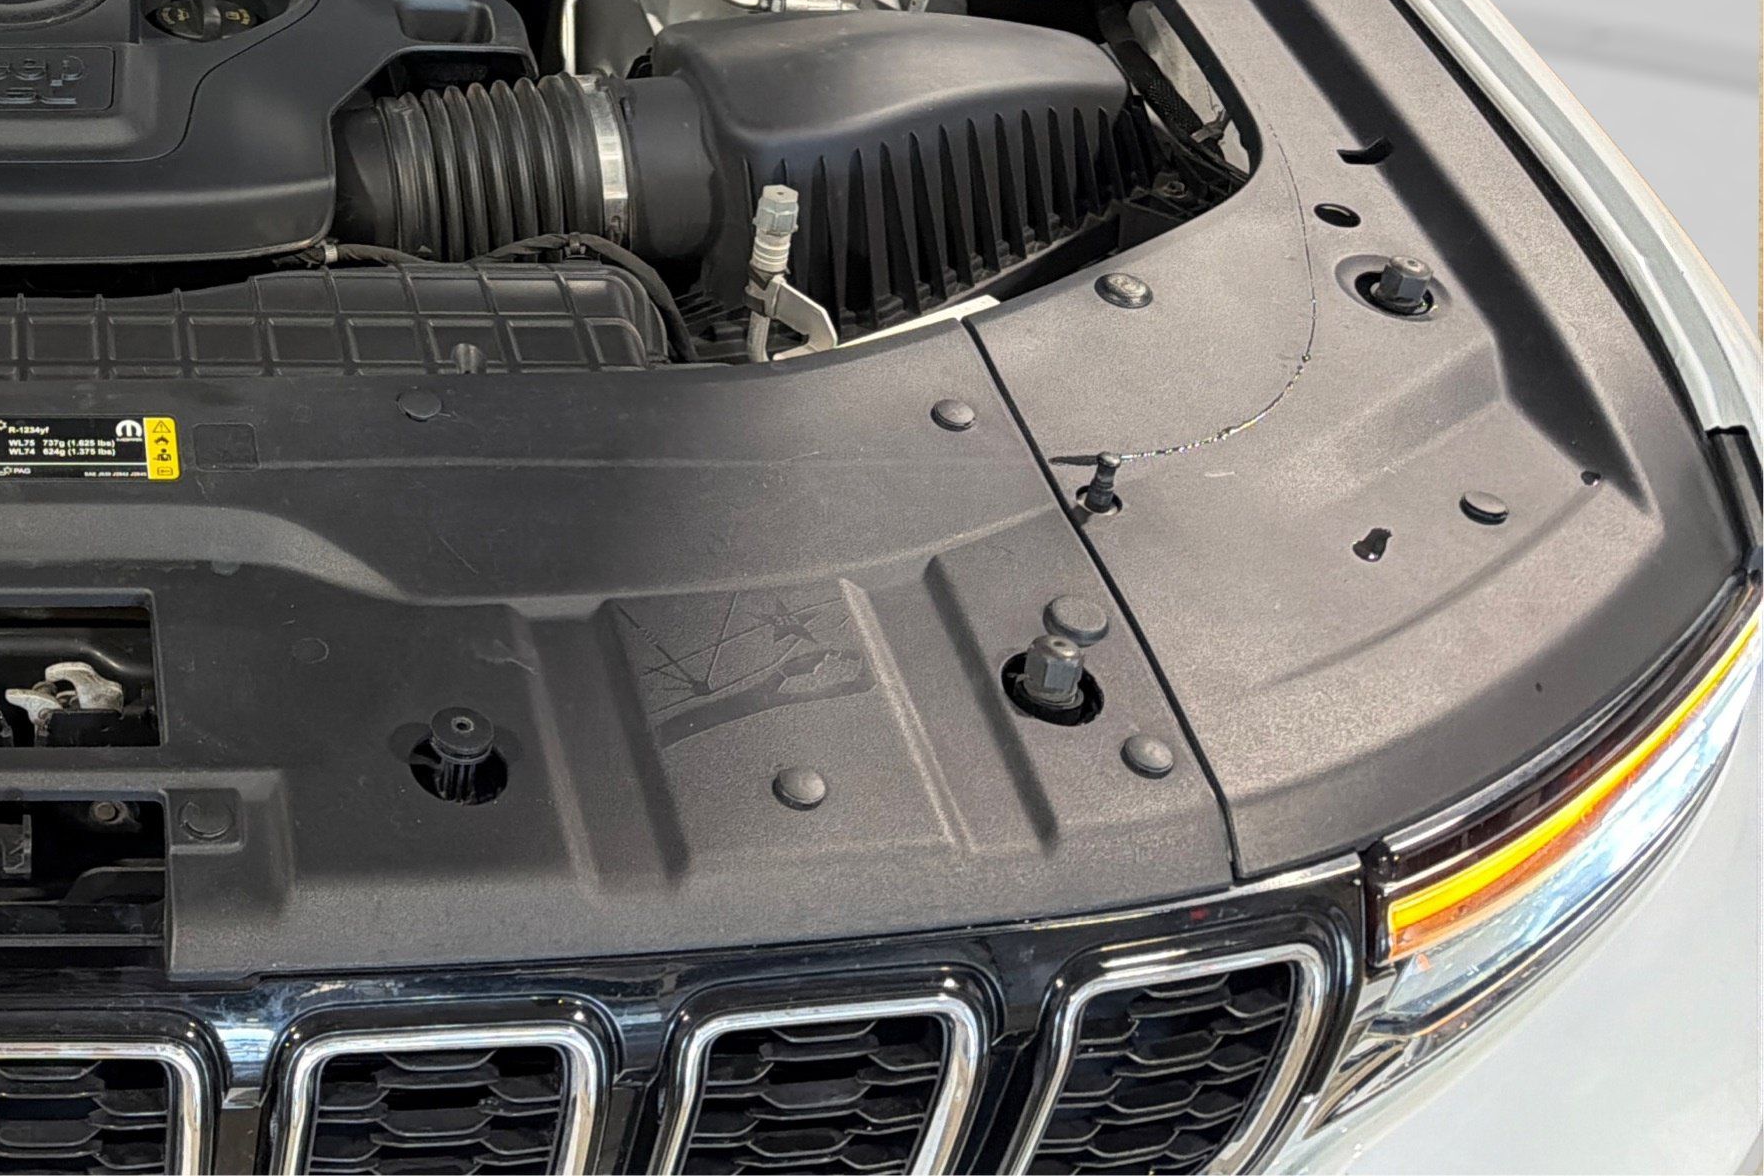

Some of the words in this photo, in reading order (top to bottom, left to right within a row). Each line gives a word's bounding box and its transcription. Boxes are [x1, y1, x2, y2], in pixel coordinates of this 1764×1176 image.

[8, 426, 50, 435] R-1234yf
[8, 439, 36, 447] WL75
[42, 439, 65, 448] 737g
[67, 439, 95, 448] (1.625
[97, 439, 115, 448] lbs)
[8, 448, 36, 456] WL74
[42, 448, 66, 457] 624g
[67, 448, 96, 457] (1.375
[98, 448, 116, 457] lbs)
